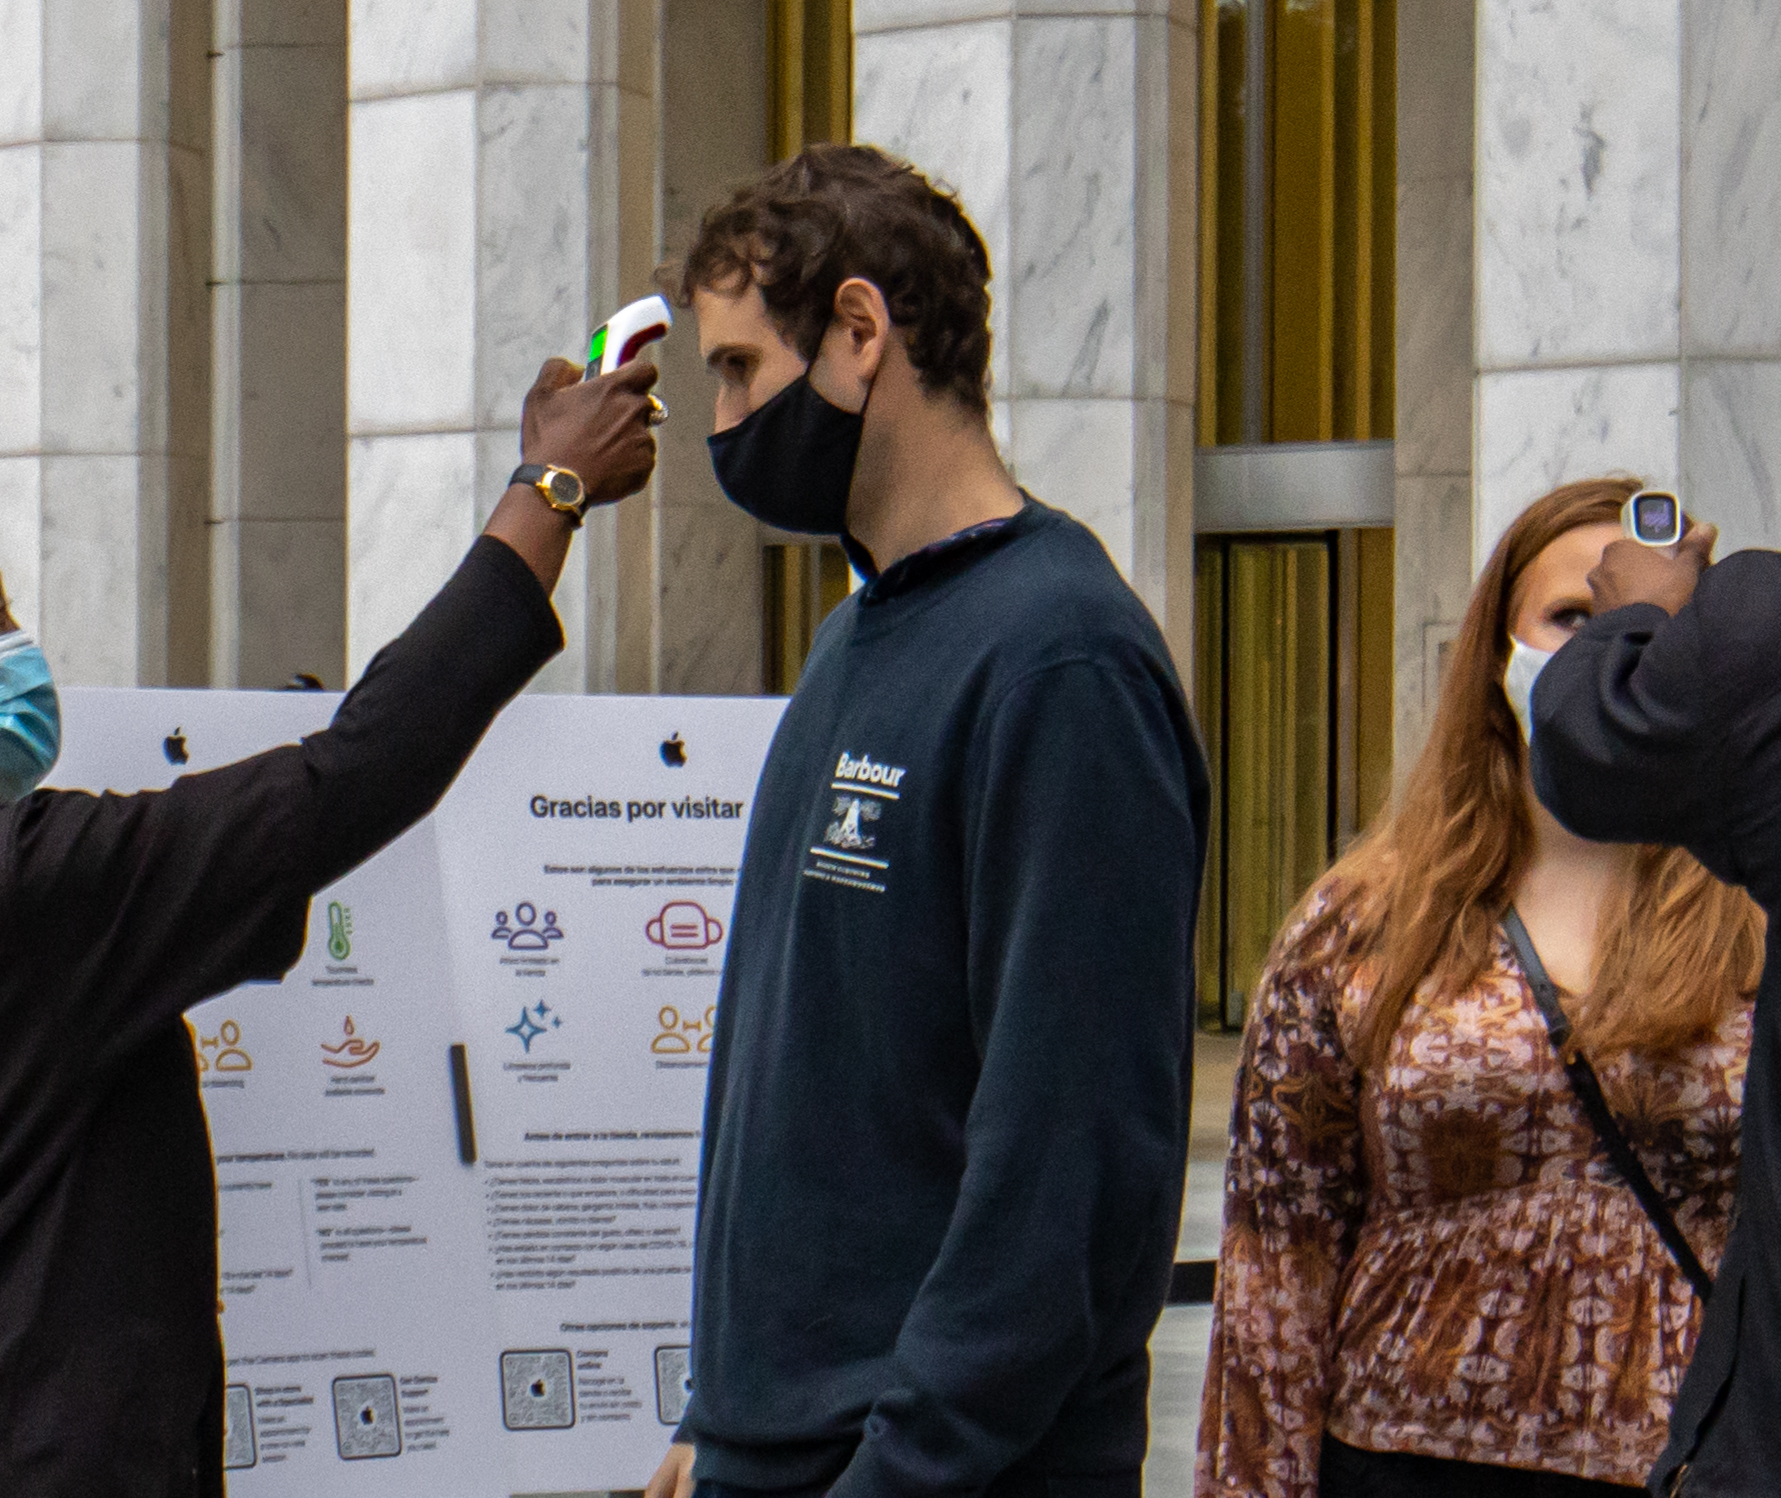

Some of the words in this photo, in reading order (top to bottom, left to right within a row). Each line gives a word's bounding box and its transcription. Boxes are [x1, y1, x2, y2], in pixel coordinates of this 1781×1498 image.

[835, 751, 906, 787] Barbour
[530, 795, 621, 818] Gracias
[627, 800, 666, 823] por
[672, 795, 744, 819] visitar
